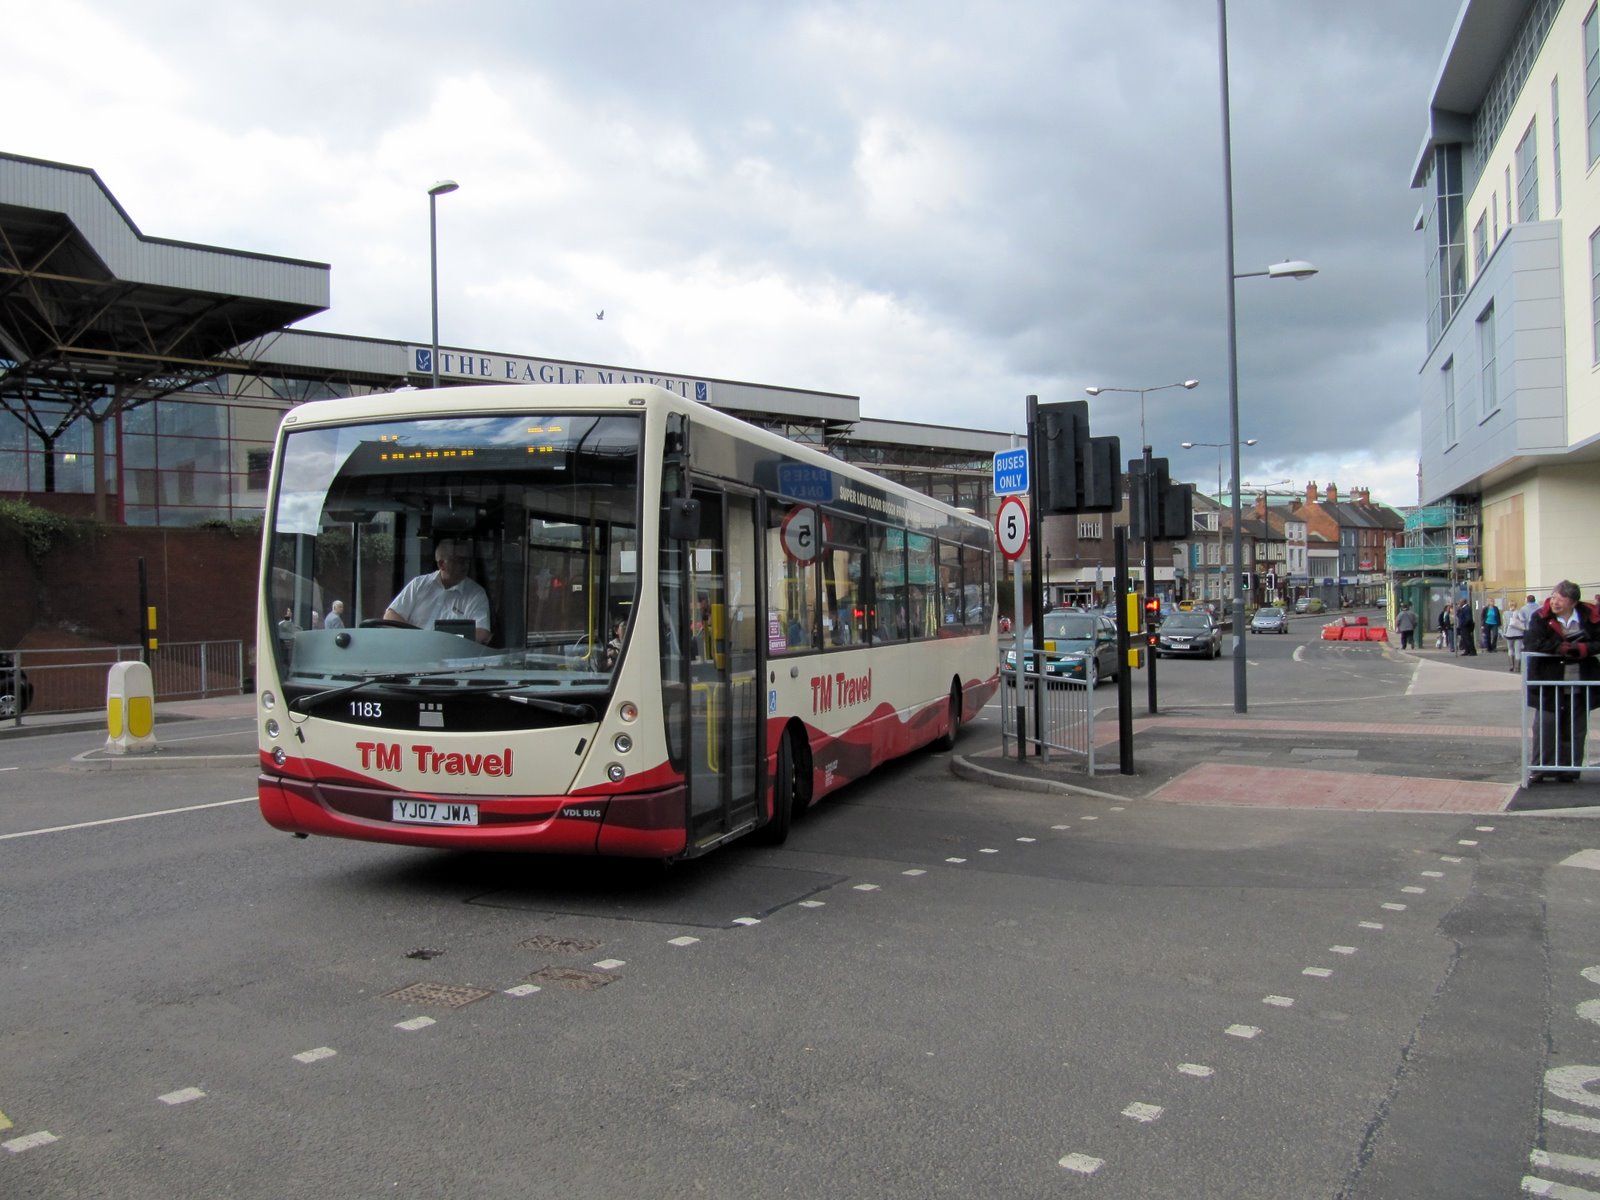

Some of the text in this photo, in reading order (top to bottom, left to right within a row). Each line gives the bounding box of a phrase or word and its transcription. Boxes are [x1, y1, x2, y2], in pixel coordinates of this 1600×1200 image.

[440, 353, 493, 377] THE
[505, 360, 586, 384] EAGLE
[996, 455, 1025, 472] BUSES
[999, 473, 1022, 489] ONLY
[839, 485, 857, 504] SUPER
[867, 495, 882, 511] FLOOR
[1007, 515, 1017, 540] 5
[811, 667, 871, 716] TM Travel
[350, 701, 382, 718] 1183
[355, 741, 513, 777] TM Travel
[399, 802, 471, 822] YJ07 JWA
[563, 808, 601, 817] VDL BUS
